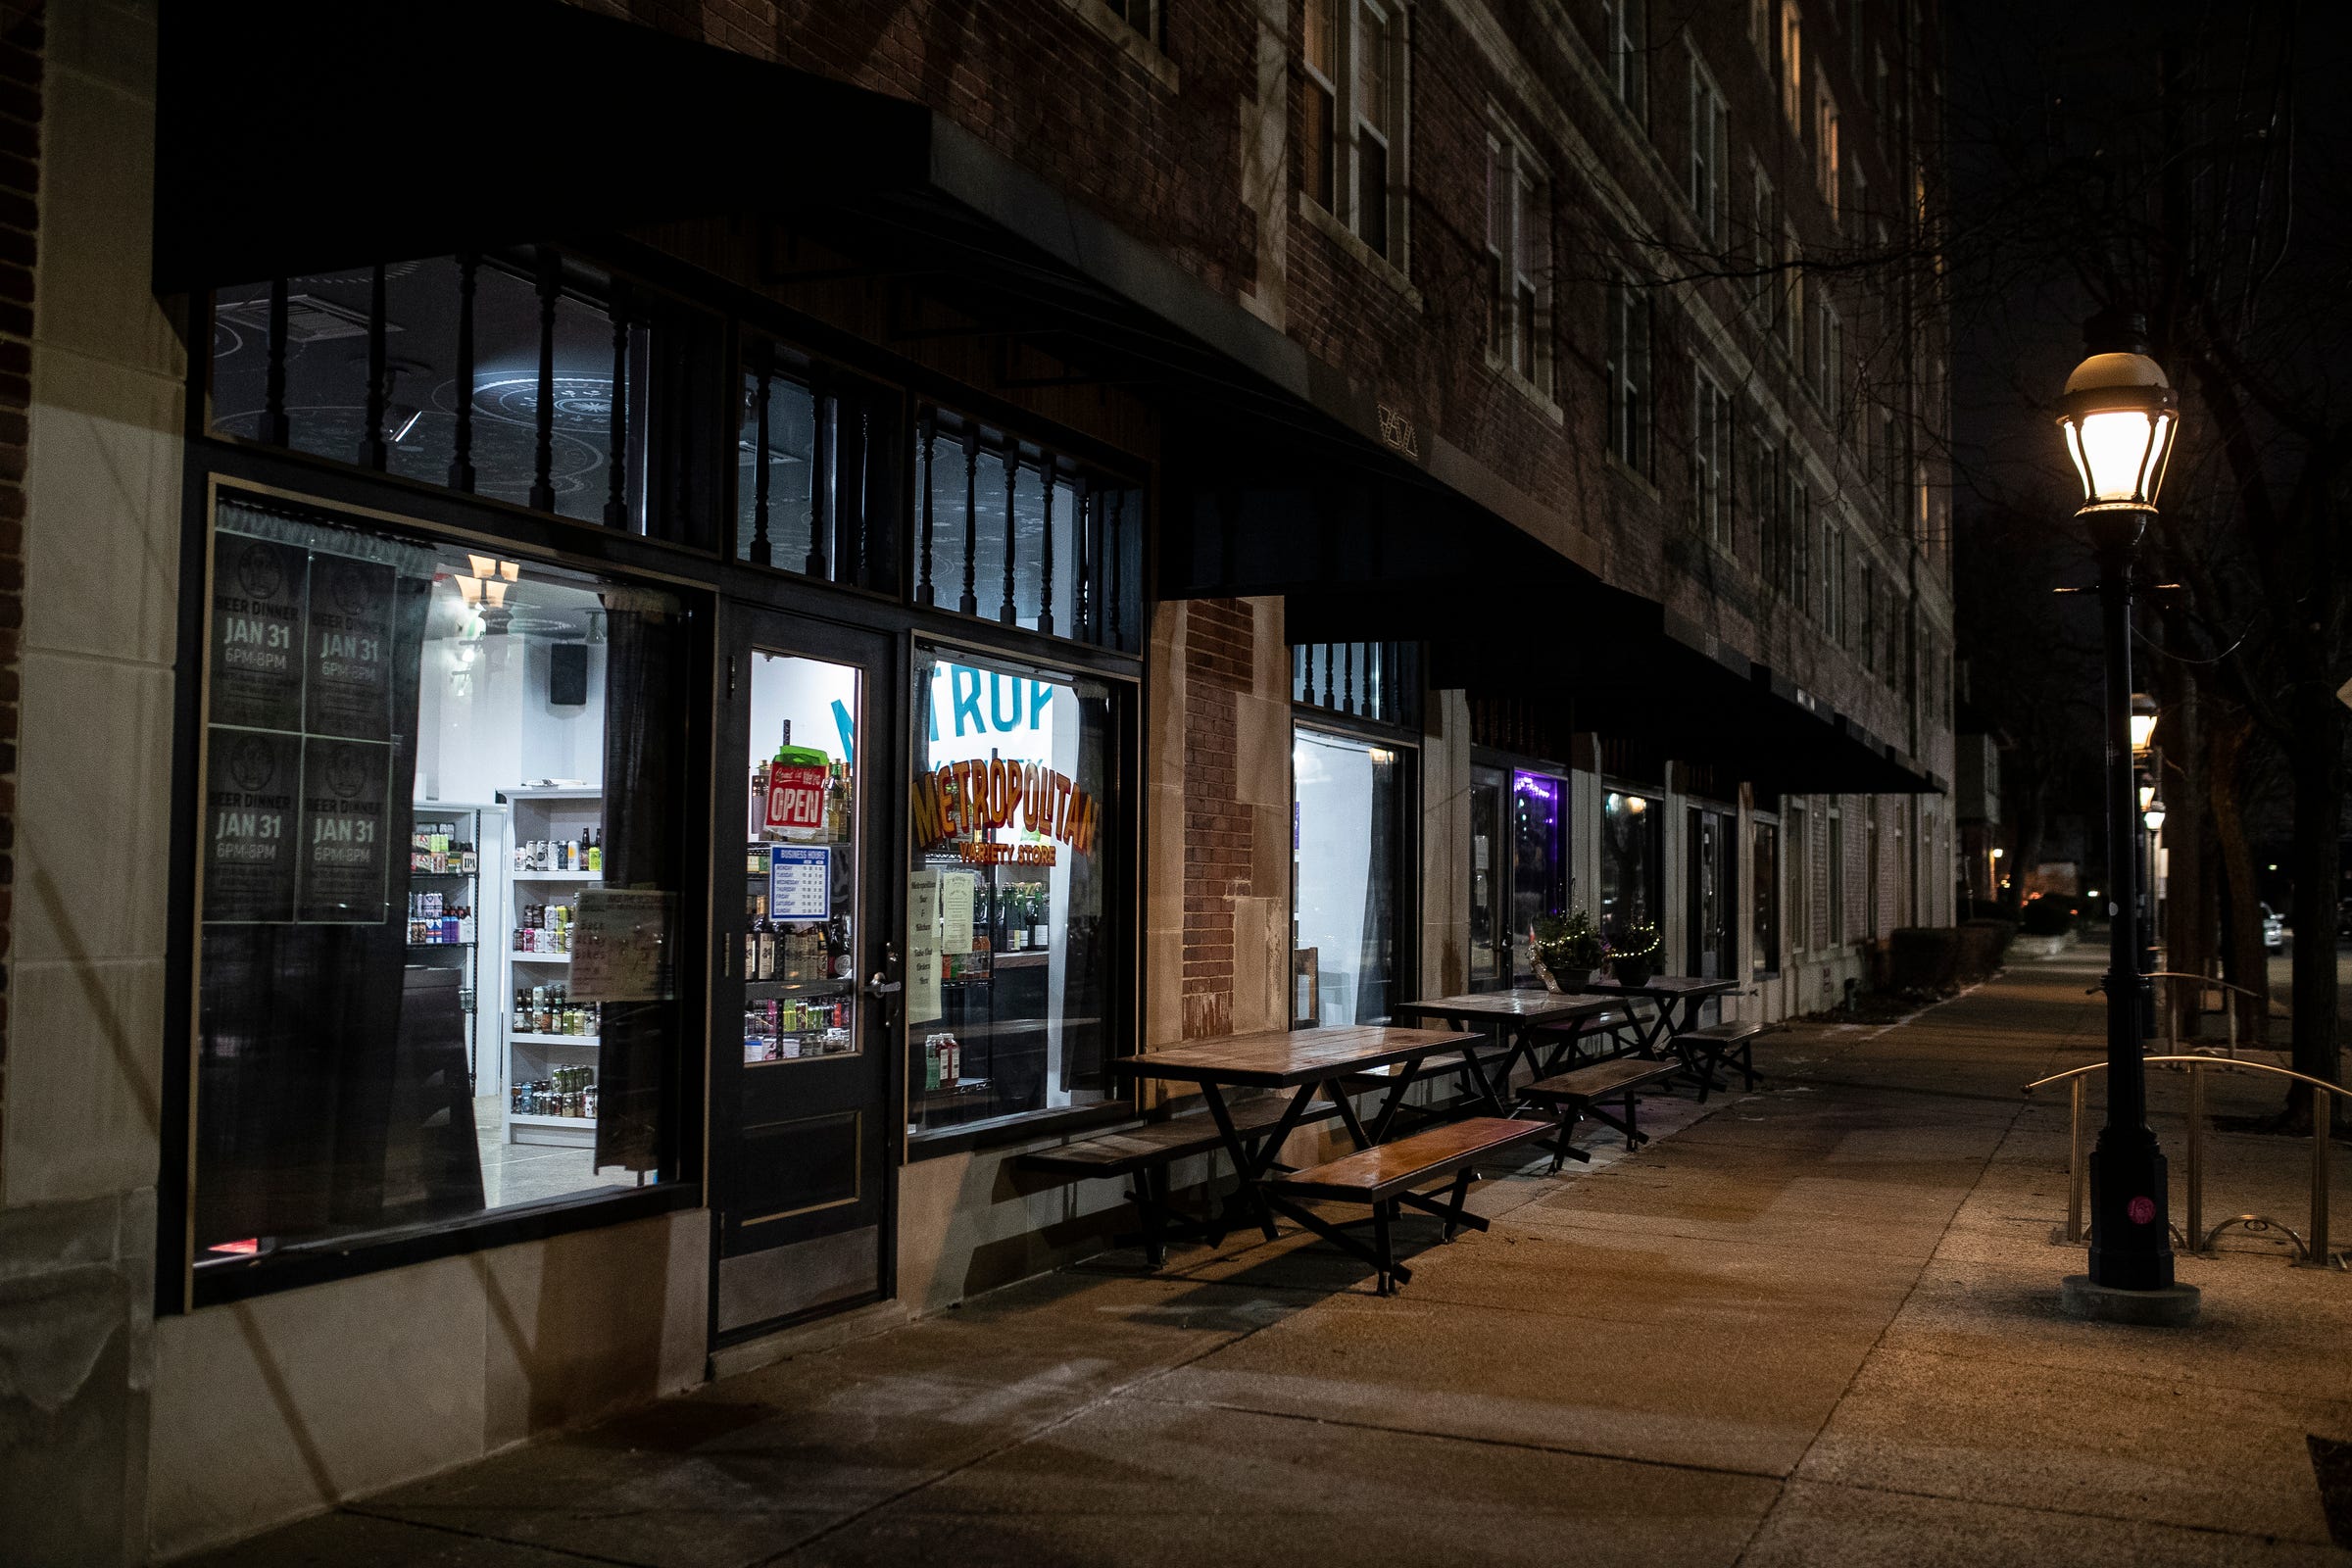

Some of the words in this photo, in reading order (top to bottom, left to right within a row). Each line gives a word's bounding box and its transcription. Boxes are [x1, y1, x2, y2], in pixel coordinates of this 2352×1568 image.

[223, 616, 265, 646] JAN
[267, 623, 290, 649] 31
[224, 647, 288, 670] 6PM-8PM
[319, 632, 357, 660] JAN
[361, 638, 379, 662] 31
[770, 787, 820, 823] OPEN
[912, 758, 1100, 857] METROPOLITAN
[216, 811, 257, 840] JAN
[259, 813, 282, 840] 31
[313, 817, 353, 845] JAN
[355, 819, 375, 844] 31
[313, 846, 371, 863] 6PM-8PM
[464, 858, 476, 869] IPA
[780, 849, 807, 859] BUSINESS
[808, 850, 826, 860] HOURS
[958, 841, 1015, 865] VARIETY
[1016, 844, 1056, 868] STORE
